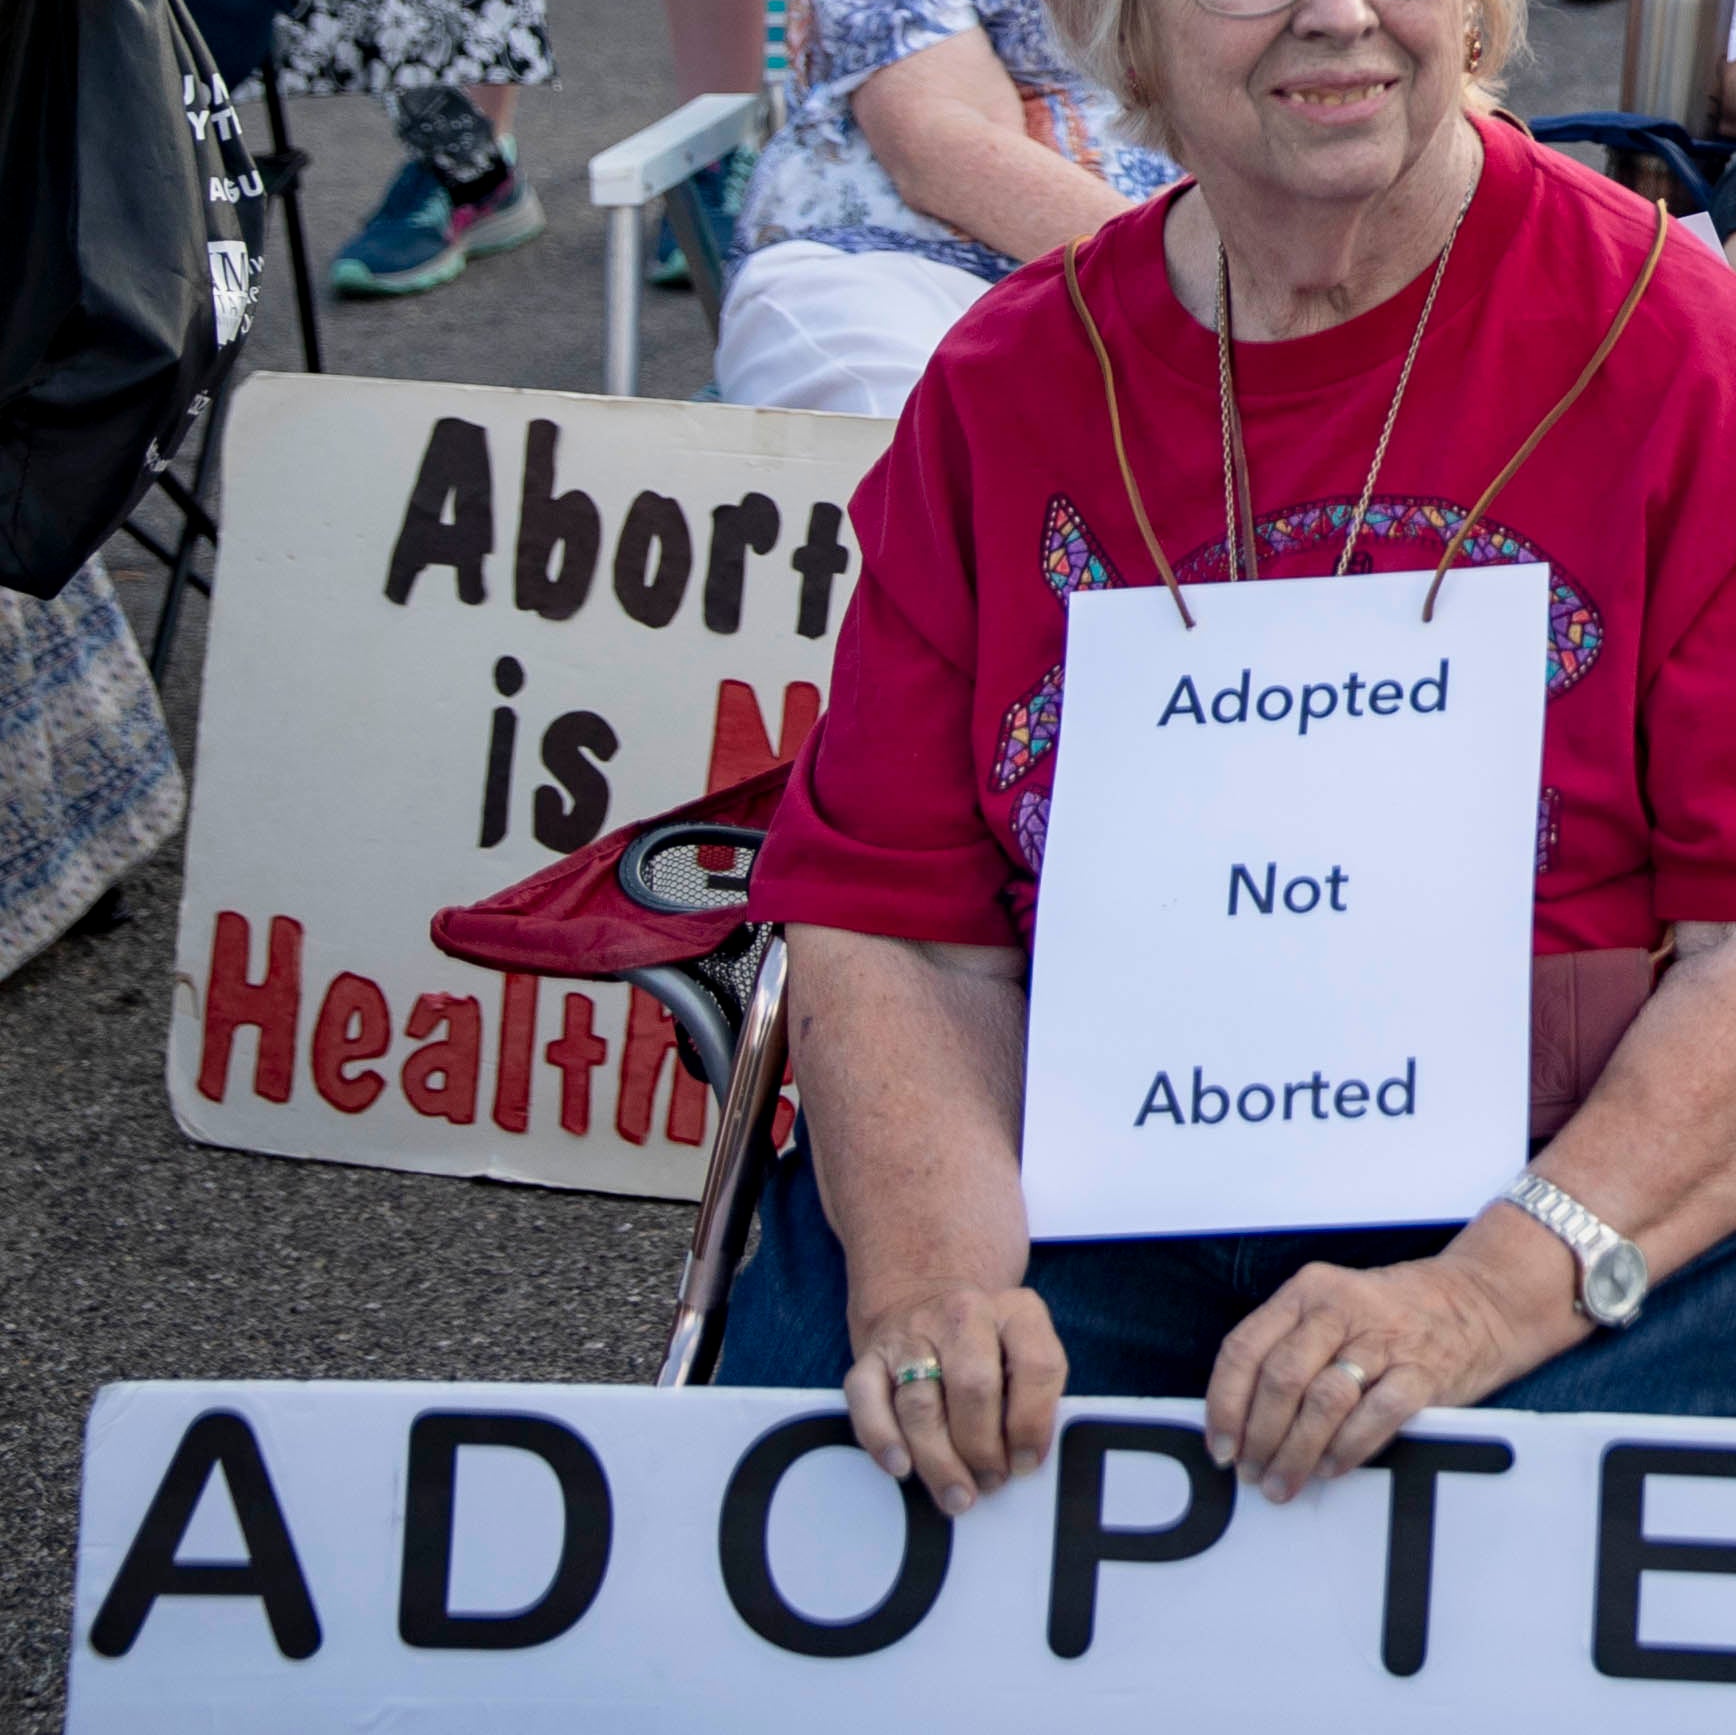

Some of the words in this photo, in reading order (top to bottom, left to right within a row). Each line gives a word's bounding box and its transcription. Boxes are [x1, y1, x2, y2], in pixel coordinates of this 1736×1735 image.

[384, 417, 850, 639] Abort
[479, 655, 620, 854] is
[1156, 657, 1450, 736] Adopted
[1227, 861, 1350, 916] Not
[196, 910, 705, 1148] Health
[1133, 1056, 1417, 1127] Aborted
